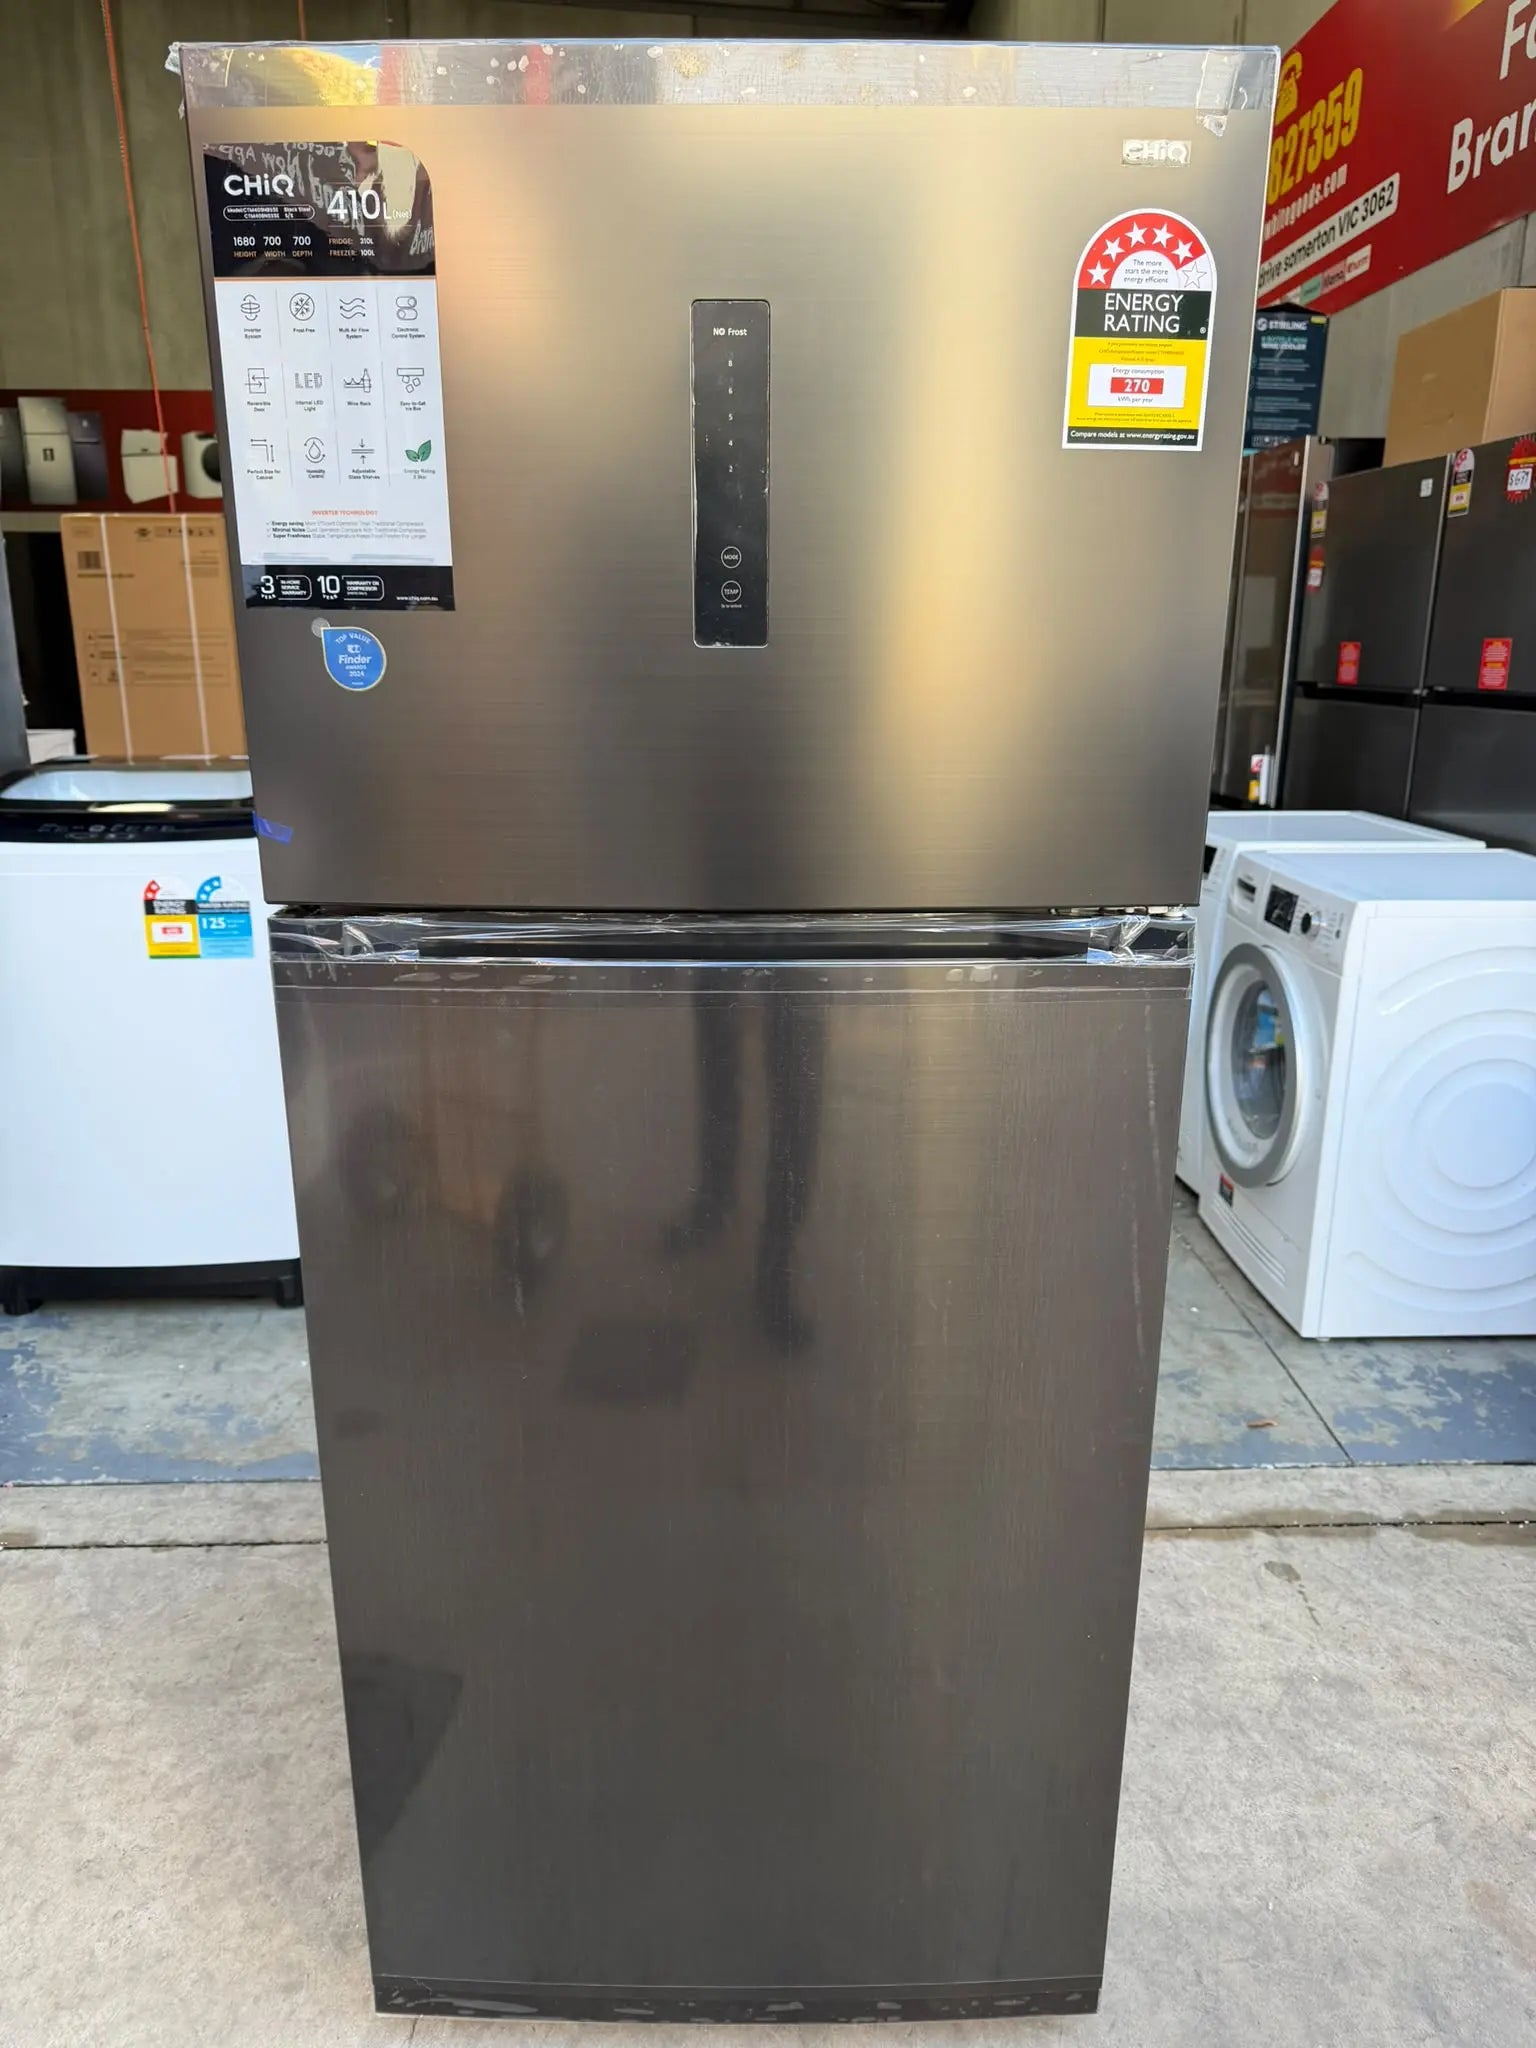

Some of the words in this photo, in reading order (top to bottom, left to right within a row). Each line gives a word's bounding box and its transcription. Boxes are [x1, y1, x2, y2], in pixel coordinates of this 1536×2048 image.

[223, 173, 295, 197] CHiQ
[1338, 205, 1359, 236] VIC
[1361, 180, 1394, 222] 3062
[233, 236, 256, 246] 1680
[262, 236, 282, 246] 700
[292, 236, 311, 246] 700
[1133, 258, 1144, 266] The
[1139, 267, 1151, 275] the
[1123, 277, 1143, 285] energy
[1145, 276, 1169, 284] efficient
[1104, 292, 1184, 313] ENERGY
[1103, 313, 1180, 334] RATING
[713, 327, 726, 336] NO
[727, 327, 748, 336] Frost
[1112, 367, 1130, 375] Energy
[1131, 368, 1165, 376] consumption
[1123, 378, 1150, 393] 270
[728, 413, 733, 421] 5
[1070, 429, 1097, 439] Compare
[1097, 431, 1118, 439] models
[728, 439, 733, 447] 4
[728, 464, 733, 473] 2
[260, 575, 275, 594] 3
[316, 575, 340, 594] 10
[338, 654, 372, 664] Finder
